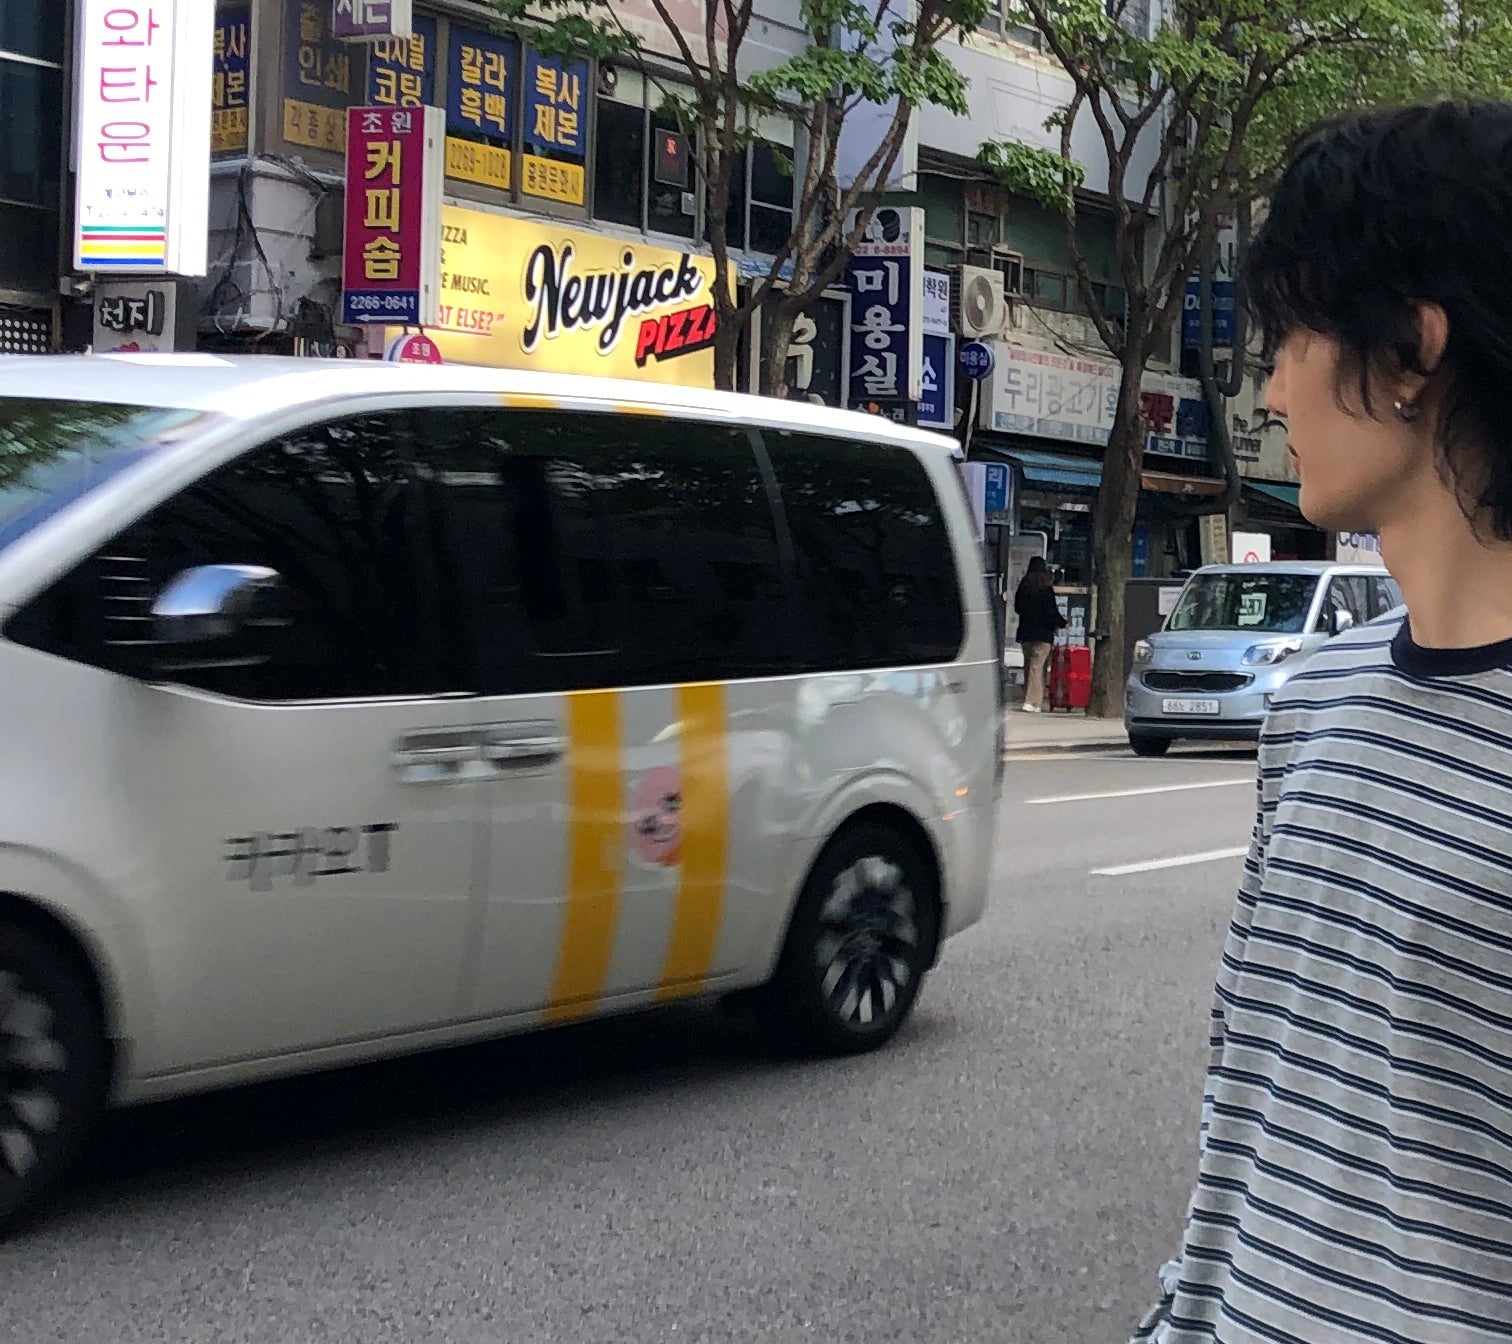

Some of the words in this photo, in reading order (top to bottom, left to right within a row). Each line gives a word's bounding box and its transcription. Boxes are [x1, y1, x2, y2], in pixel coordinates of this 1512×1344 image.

[460, 45, 507, 92] 칼라
[536, 64, 580, 111] 복사
[460, 88, 506, 133] 흑백
[533, 104, 579, 146] 제본
[363, 140, 401, 280] 커피숍
[451, 272, 490, 296] MUSIC.
[523, 244, 699, 349] Newjack
[850, 260, 905, 396] 미용실
